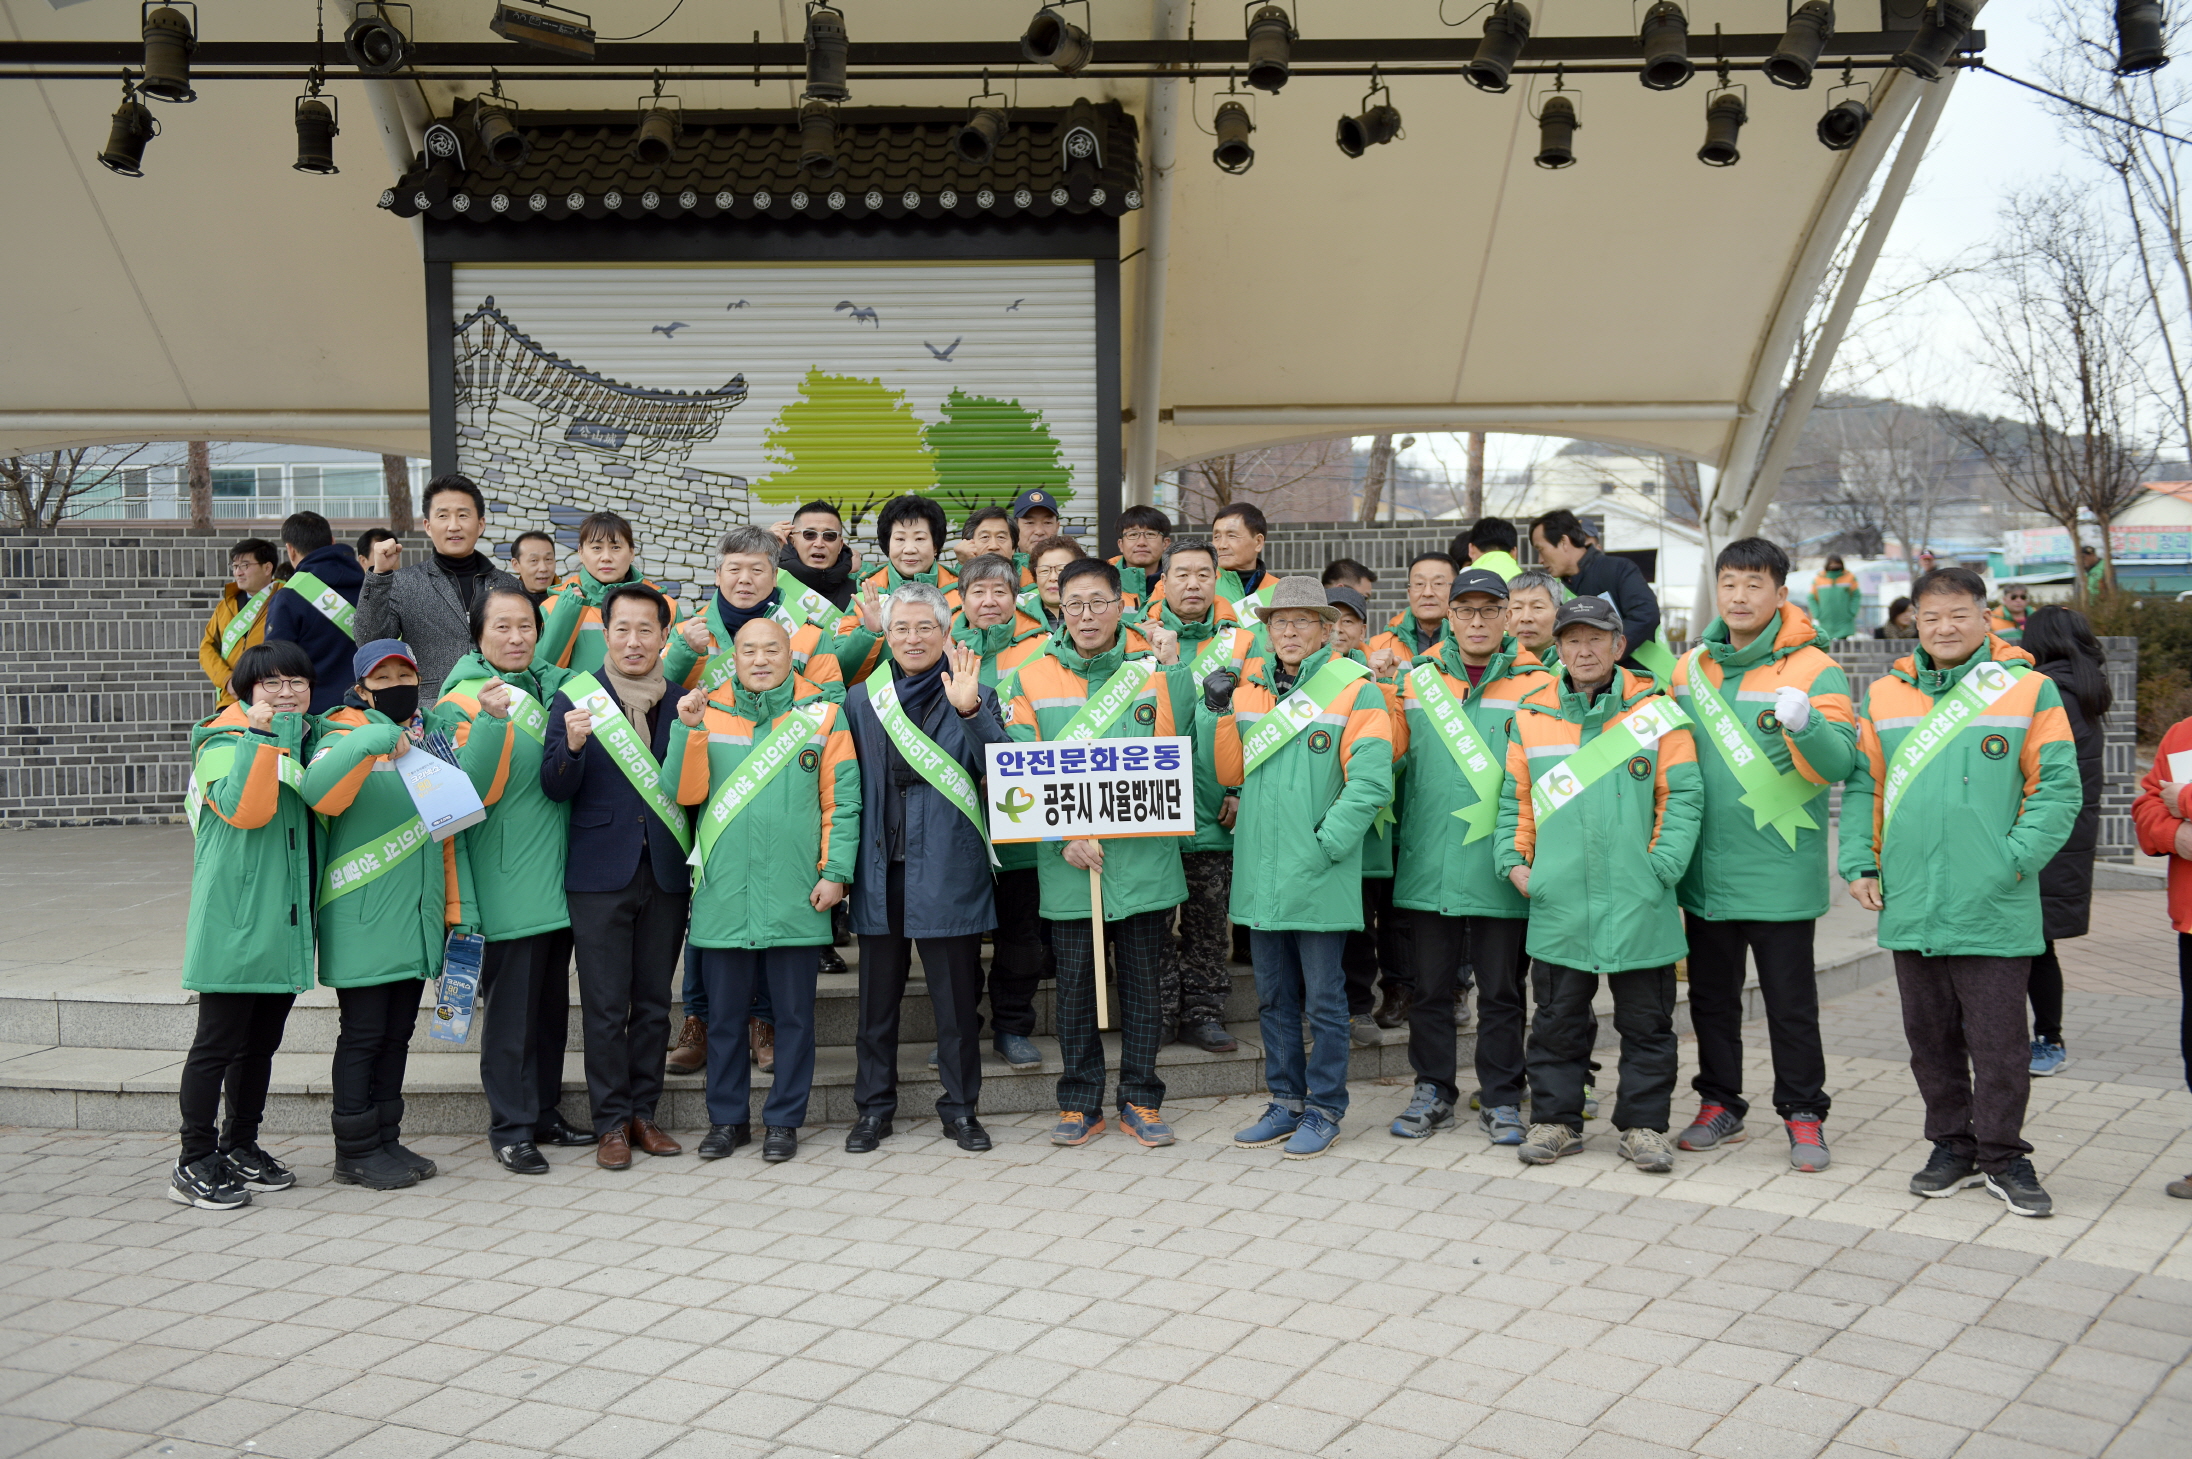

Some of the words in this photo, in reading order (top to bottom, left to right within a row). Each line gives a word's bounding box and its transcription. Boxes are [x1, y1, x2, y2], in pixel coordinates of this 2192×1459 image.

[579, 425, 617, 448] 公山城
[1088, 669, 1140, 728] 안전의식
[752, 721, 808, 781] 안전의식
[1715, 714, 1756, 767] 생활화
[1904, 699, 1971, 767] 안전의식
[891, 714, 944, 770] 안전의식
[939, 765, 977, 811] 생활화
[996, 744, 1181, 777] 안전문화운동
[711, 775, 756, 823] 생활화
[1043, 782, 1092, 826] 공주시
[1098, 778, 1182, 823] 자율방재단
[329, 852, 381, 890] 생활화
